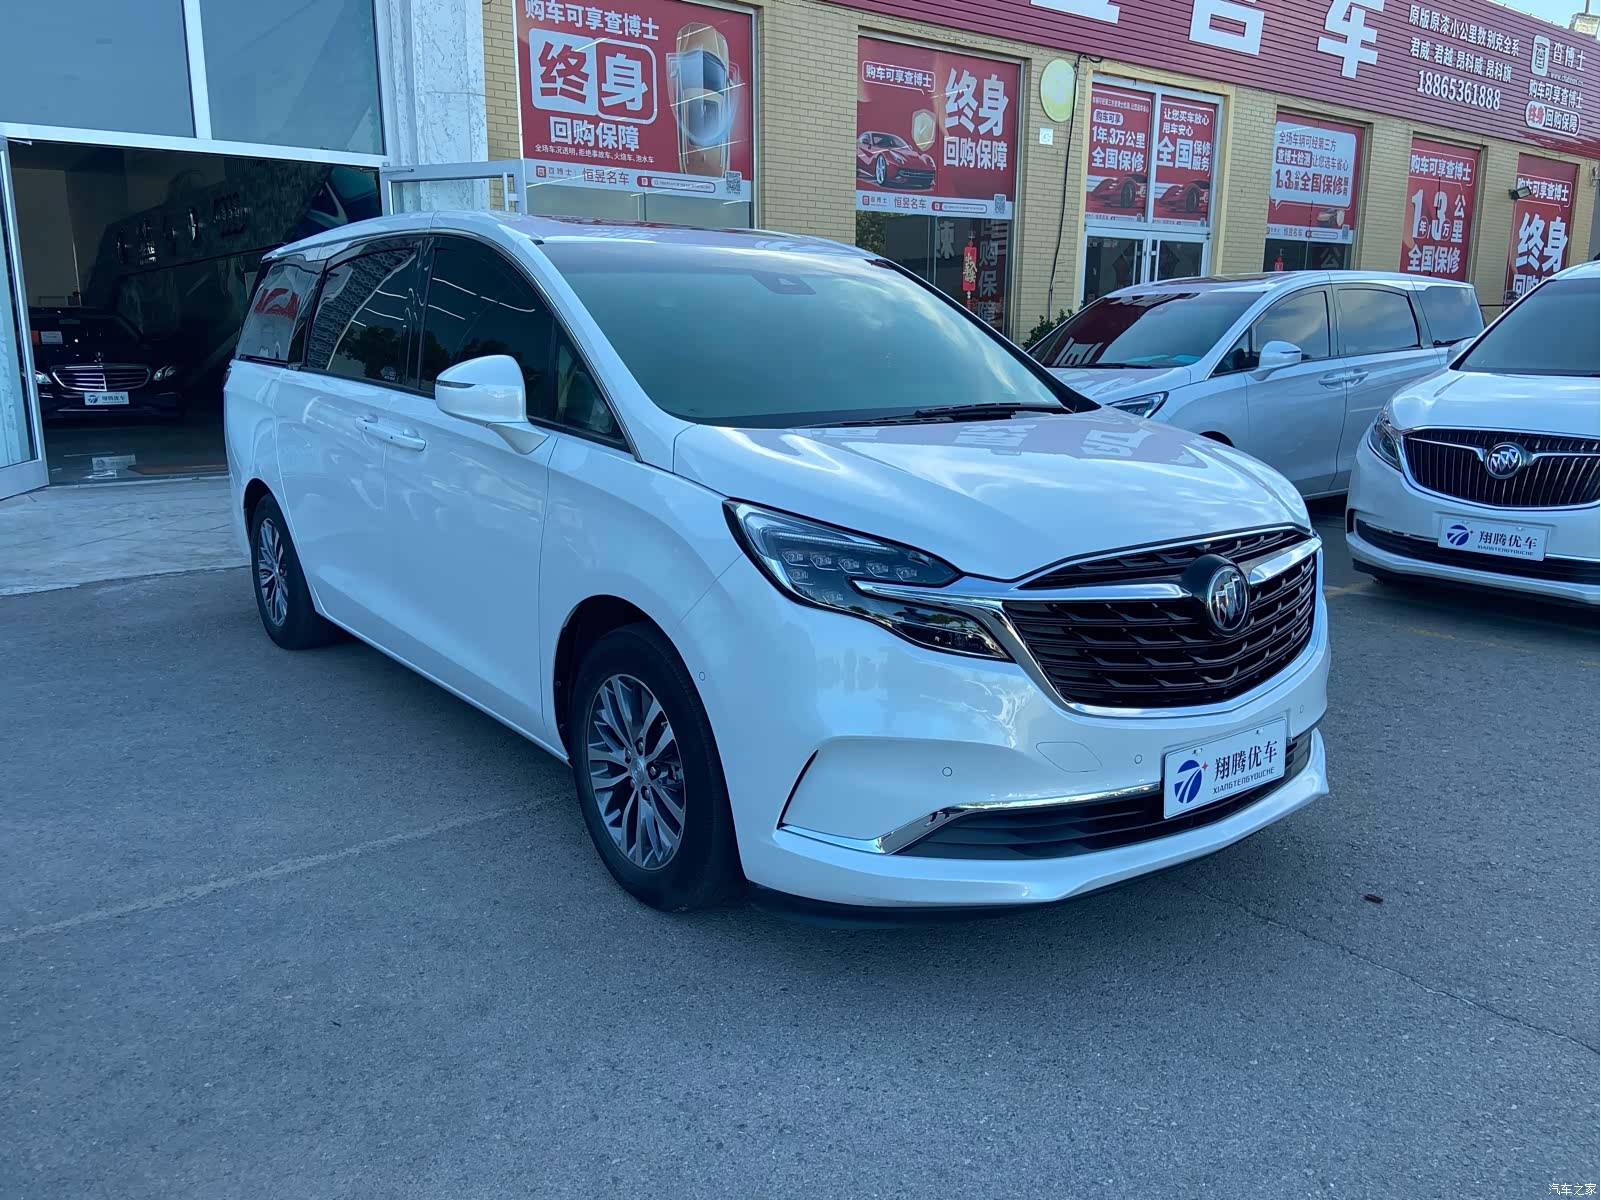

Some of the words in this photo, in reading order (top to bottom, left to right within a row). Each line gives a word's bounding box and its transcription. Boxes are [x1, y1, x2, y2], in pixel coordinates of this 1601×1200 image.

[525, 0, 660, 40] 购车可享查博士
[1409, 5, 1520, 57] 原版原漆小公里数别克全系
[1410, 37, 1431, 61] 君威
[1434, 44, 1454, 67] 君越
[1456, 51, 1484, 75] 昂科威
[1486, 60, 1512, 83] 昂科旗
[1553, 42, 1586, 71] 查博士
[538, 41, 648, 111] 终身
[865, 64, 932, 88] 购车可享查博士
[1417, 70, 1501, 110] 18865361888
[944, 67, 1009, 137] 终身
[1528, 79, 1584, 109] 购车可享查博士
[1095, 110, 1122, 124] 购车可享
[1162, 122, 1194, 137] 用车安心
[1163, 108, 1210, 126] 让您买车放心
[1545, 109, 1578, 133] 回购保障
[549, 116, 640, 152] 回购保障
[1279, 131, 1337, 152] 全场车辆可经第三方
[943, 136, 1008, 171] 回购保障
[1091, 146, 1145, 172] 全国保修
[1156, 136, 1194, 170] 全国
[1193, 140, 1211, 156] 保修
[1410, 154, 1472, 181] 购车可享查博士
[582, 167, 630, 185] 恒昱名车
[894, 196, 927, 209] 恒昱名车
[1515, 211, 1568, 272] 终身
[1407, 244, 1461, 274] 全国保修
[1513, 273, 1551, 296] 回购
[1479, 531, 1537, 549] 翔腾优车
[1214, 741, 1278, 781] 翔腾优车
[1212, 766, 1275, 795] XIANGTENGYOUCHE
